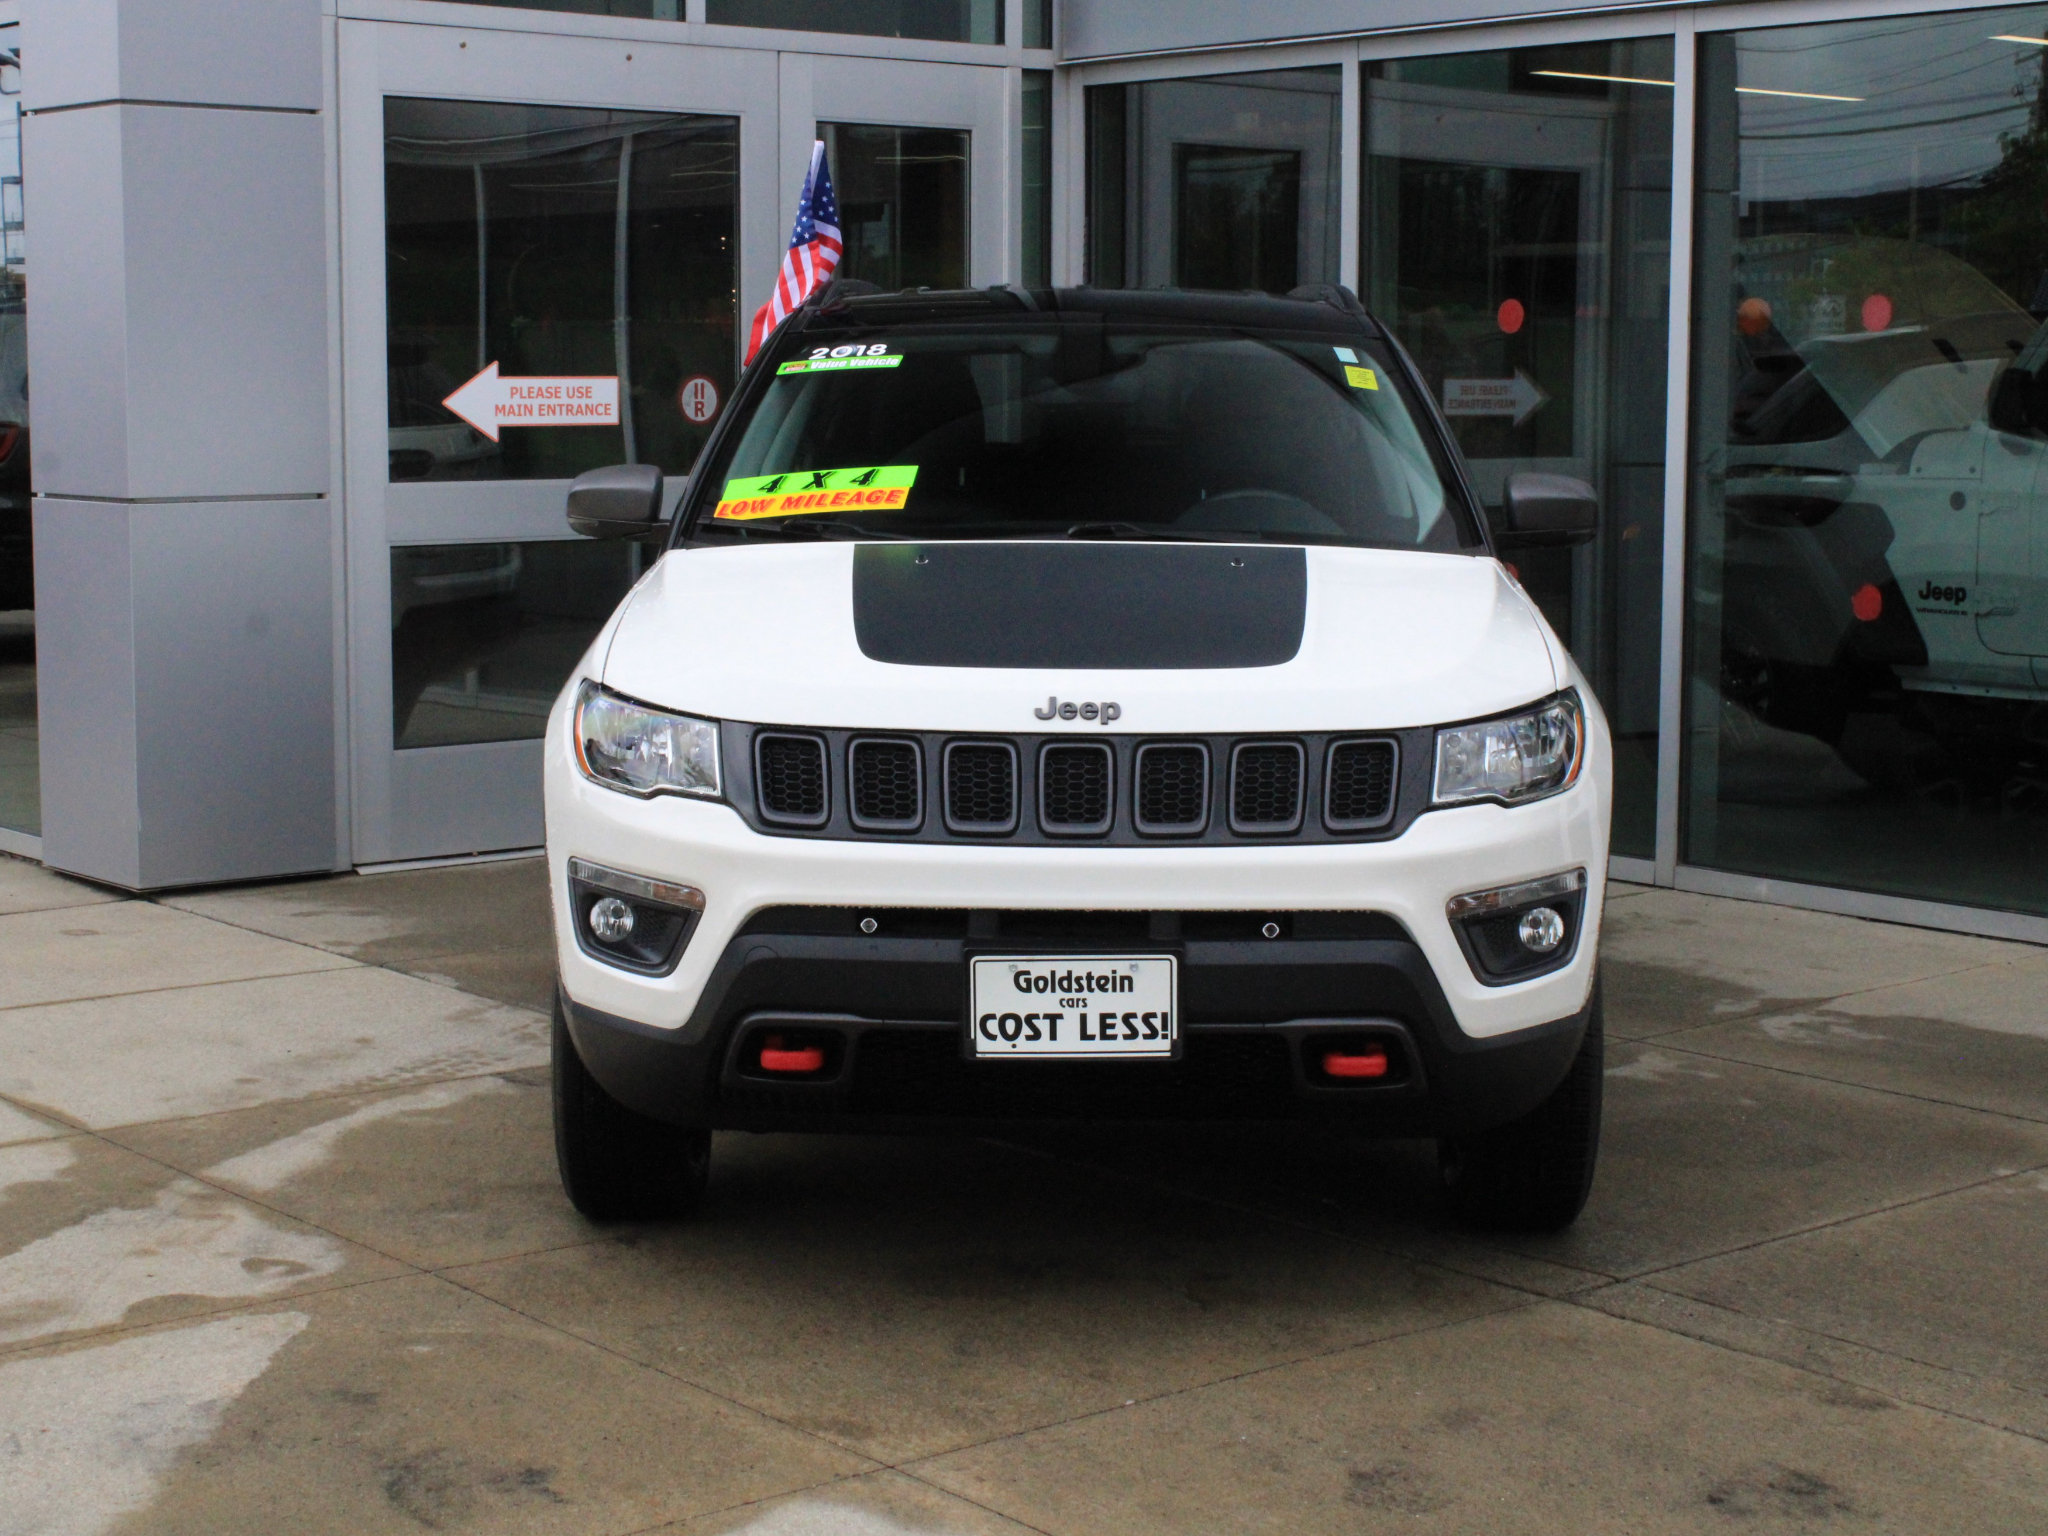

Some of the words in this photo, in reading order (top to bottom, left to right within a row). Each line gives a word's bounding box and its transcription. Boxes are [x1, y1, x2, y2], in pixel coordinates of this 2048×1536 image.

[808, 343, 888, 360] 2018
[809, 357, 848, 370] Value
[849, 356, 900, 368] Vehicle
[510, 386, 562, 399] PLEASE
[566, 386, 593, 399] USE
[494, 404, 533, 417] MAIN
[538, 403, 612, 417] ENTRANCE
[694, 401, 705, 418] R
[716, 499, 776, 518] LOW
[780, 489, 905, 511] MILEAGE
[1918, 580, 1967, 606] Jeep
[1034, 696, 1121, 725] Jeep
[1013, 970, 1134, 993] Goldstein
[1059, 997, 1088, 1008] cars
[979, 1013, 1064, 1042] COST
[1079, 1012, 1169, 1041] LESS!
